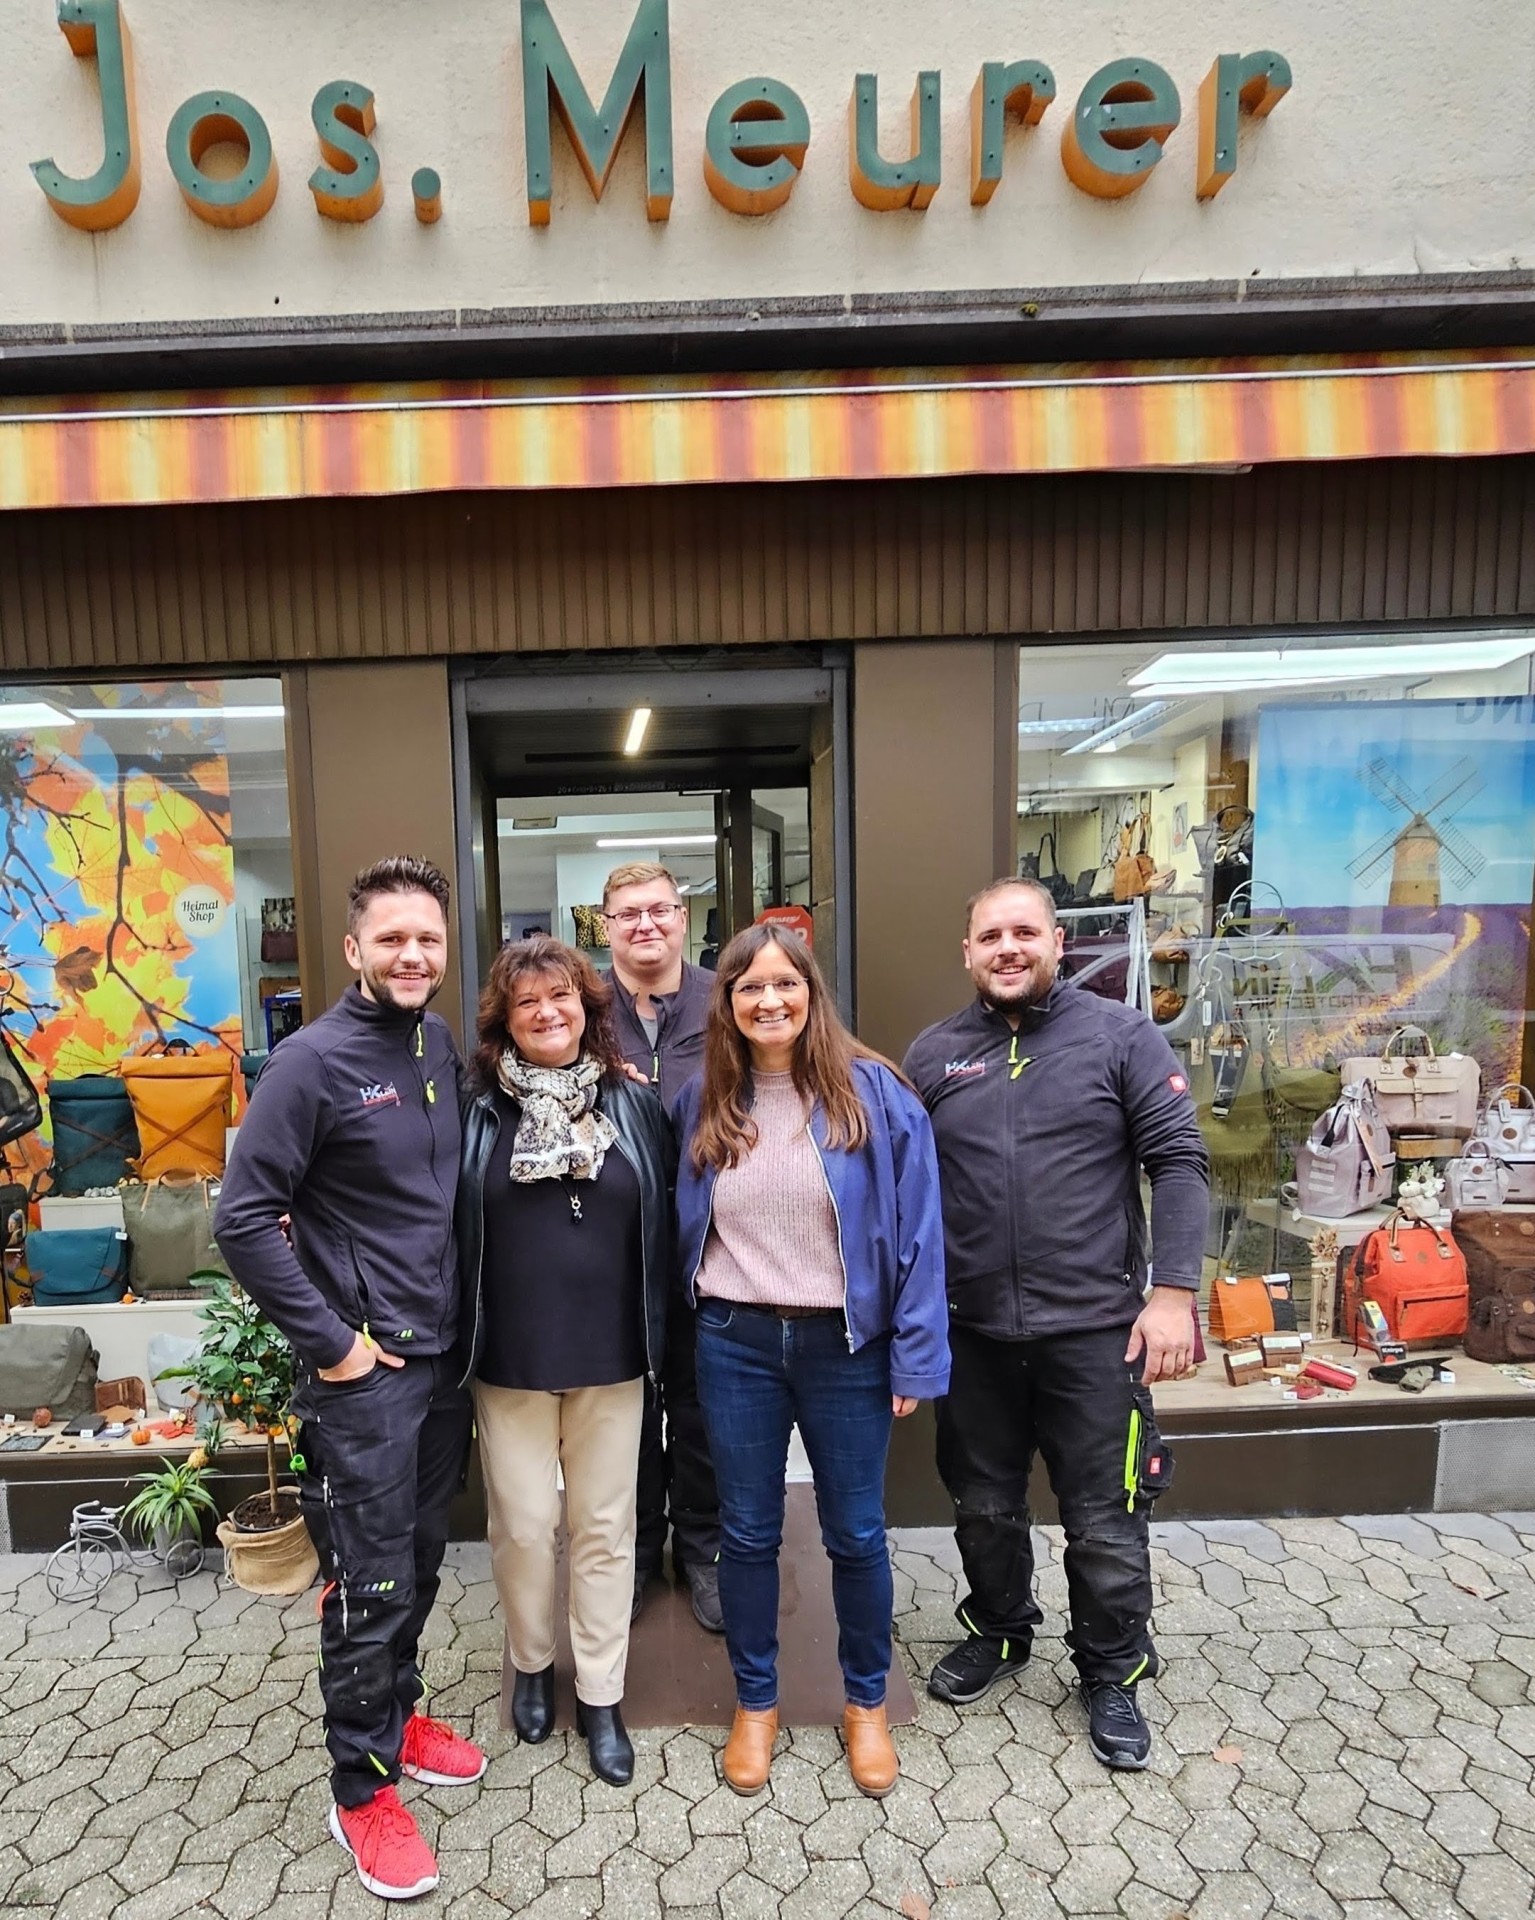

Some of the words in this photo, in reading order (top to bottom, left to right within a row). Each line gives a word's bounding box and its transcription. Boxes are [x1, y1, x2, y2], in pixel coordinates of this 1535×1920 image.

[29, 0, 443, 231] Jos.
[520, 0, 1292, 226] Meurer
[189, 912, 215, 923] Shop
